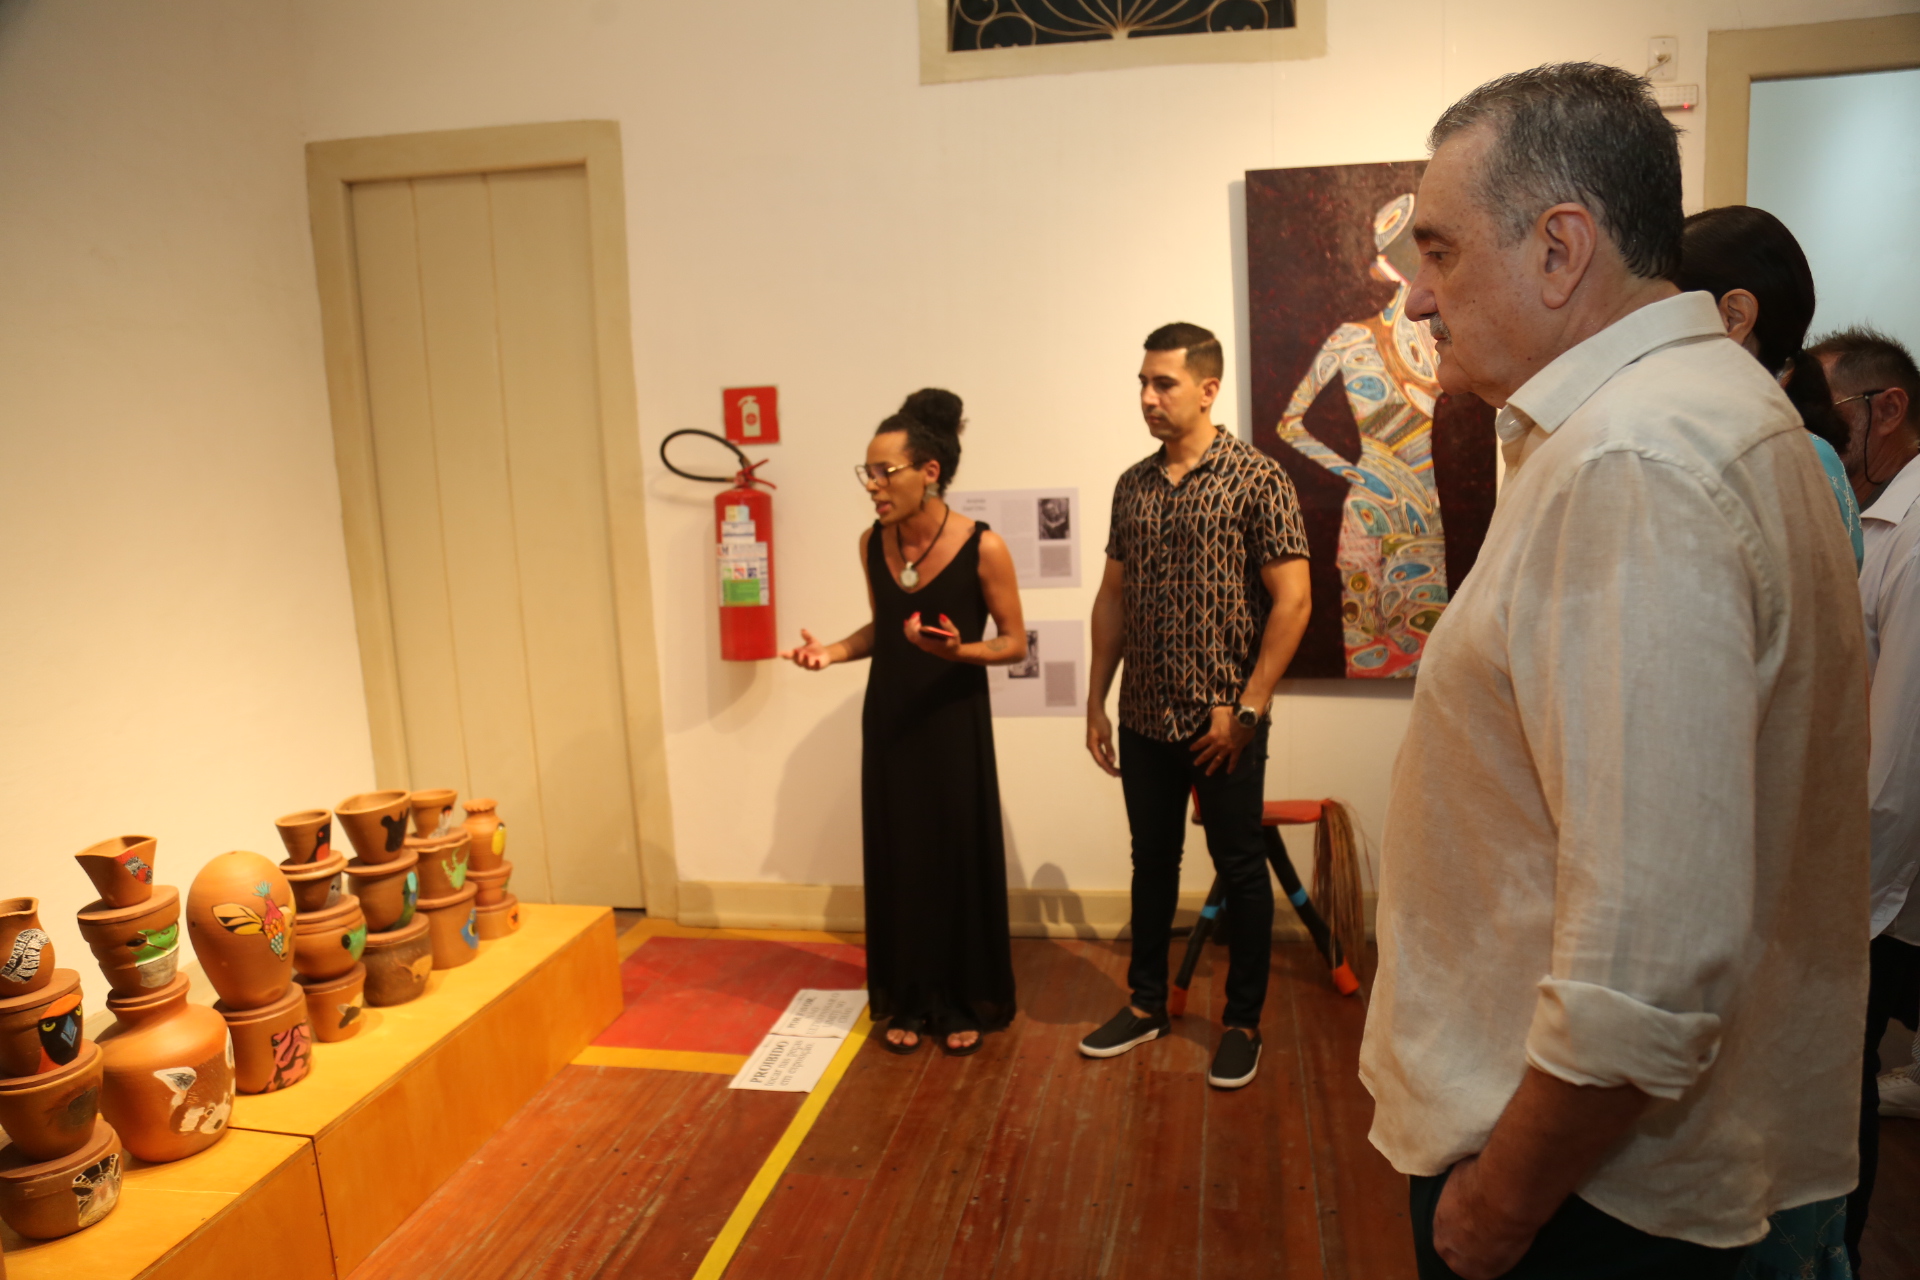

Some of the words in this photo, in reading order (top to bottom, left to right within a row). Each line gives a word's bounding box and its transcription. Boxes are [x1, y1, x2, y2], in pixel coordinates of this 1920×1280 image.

[749, 1040, 790, 1084] PROIBIDO
[778, 1058, 791, 1068] nas
[779, 1075, 793, 1086] em
